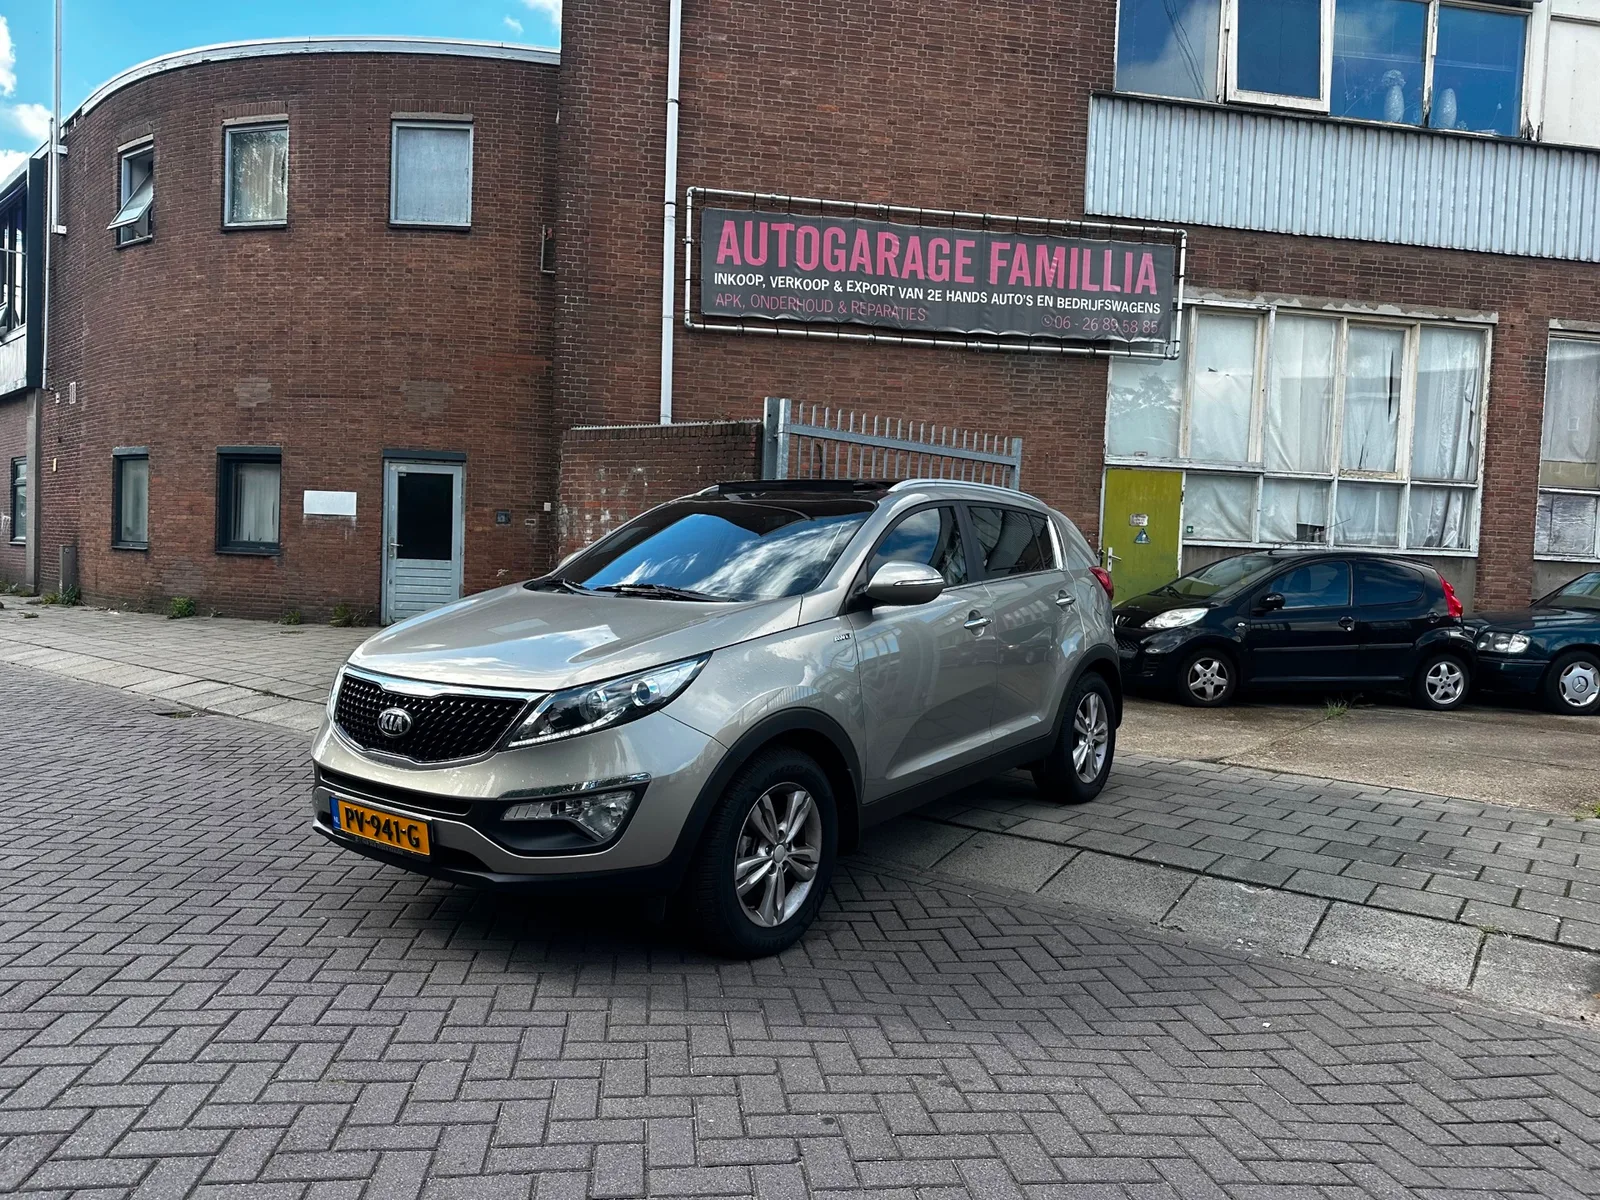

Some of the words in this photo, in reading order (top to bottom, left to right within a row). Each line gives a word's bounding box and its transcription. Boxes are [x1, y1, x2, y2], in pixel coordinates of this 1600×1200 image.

[716, 220, 976, 284] AUTOGARAGE
[989, 241, 1158, 295] FAMILLIA
[714, 272, 766, 289] INKOOP,
[769, 275, 830, 291] VERKOOP
[833, 280, 843, 292] &
[846, 280, 896, 297] EXPORT
[898, 286, 924, 300] VAN
[927, 288, 942, 302] 2E
[946, 290, 988, 304] HANDS
[991, 293, 1033, 306] AUTO'S
[1037, 295, 1054, 307] EN
[1056, 297, 1161, 314] BEDRIJFSWAGENS
[715, 293, 745, 310] APK,
[750, 293, 834, 313] ONDERHOUD
[837, 301, 847, 314] &
[851, 301, 927, 322] REPARATIES
[1054, 315, 1071, 329] 06
[1082, 317, 1099, 331] 26
[1102, 318, 1118, 332] 89
[1122, 319, 1138, 334] 58
[1142, 320, 1158, 334] 85
[381, 713, 403, 732] KIA
[333, 815, 340, 824] NL
[344, 805, 420, 848] PV-941-G
